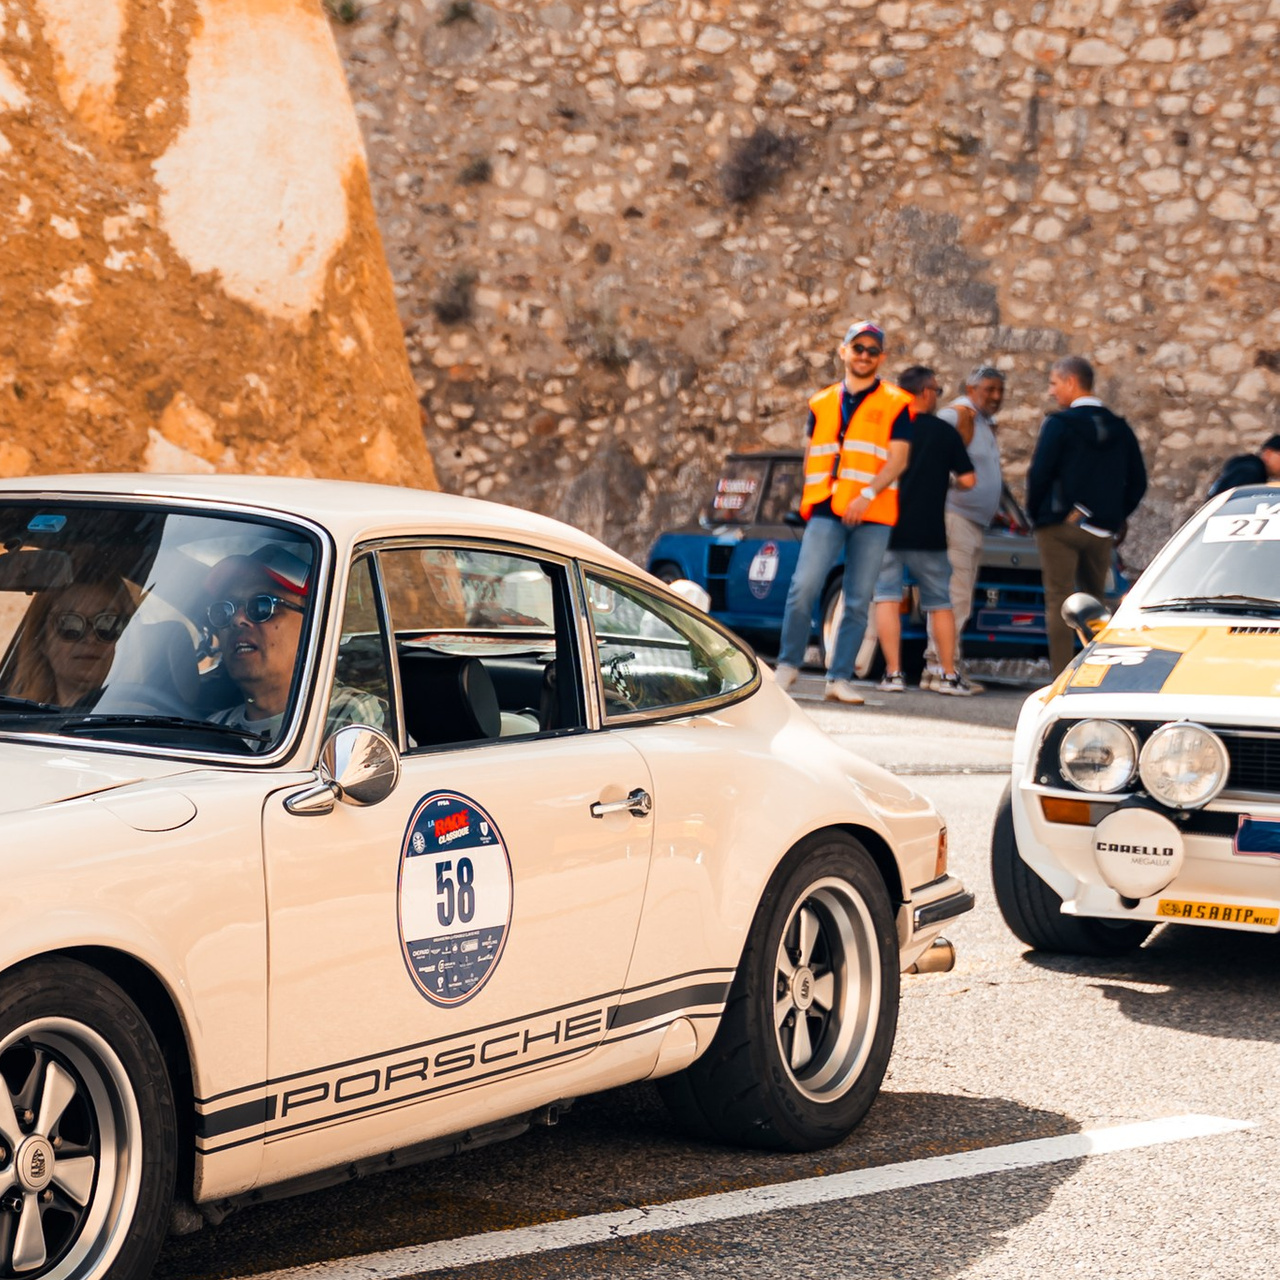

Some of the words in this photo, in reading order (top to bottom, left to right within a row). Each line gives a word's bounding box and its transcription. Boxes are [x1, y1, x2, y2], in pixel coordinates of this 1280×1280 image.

[427, 819, 435, 829] LA
[434, 808, 470, 839] RADE
[438, 825, 470, 846] CLASSIQUE
[1095, 841, 1174, 857] CARELLO
[1130, 856, 1171, 867] MEGALUX
[434, 856, 476, 928] 58
[281, 1009, 603, 1118] PORSCHE
